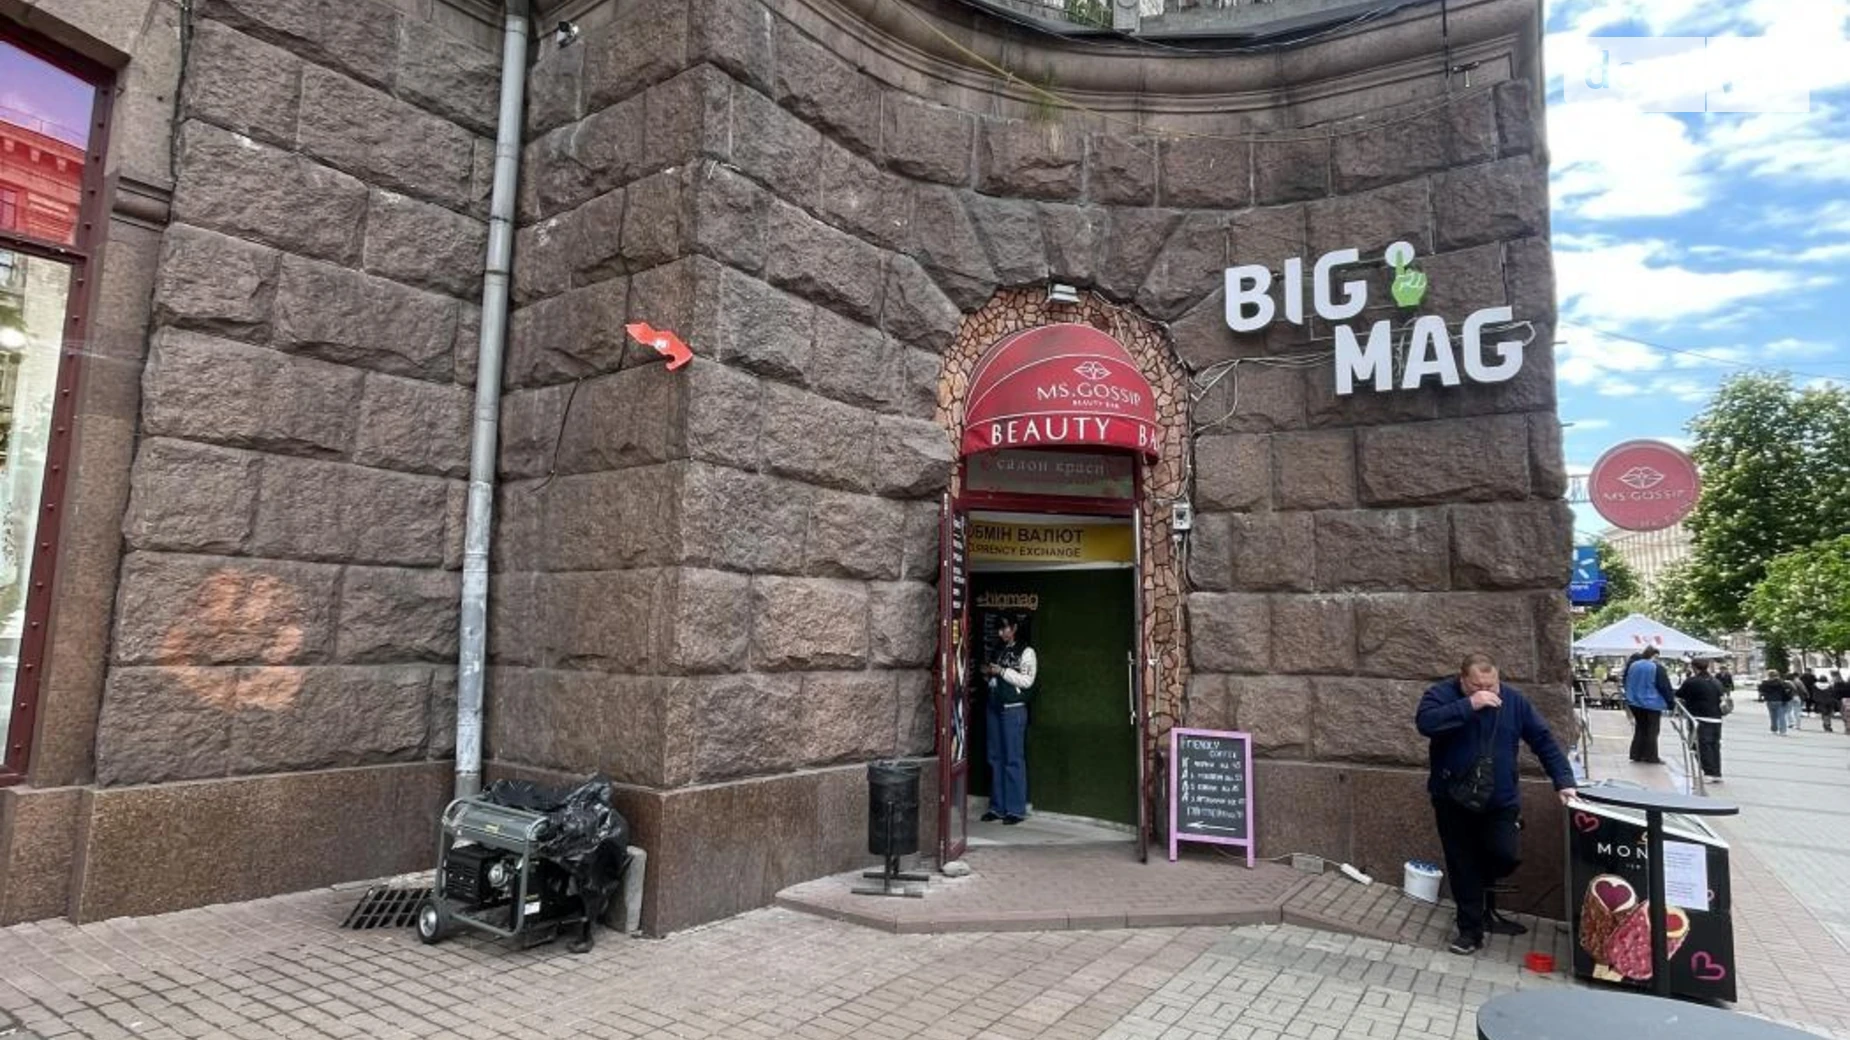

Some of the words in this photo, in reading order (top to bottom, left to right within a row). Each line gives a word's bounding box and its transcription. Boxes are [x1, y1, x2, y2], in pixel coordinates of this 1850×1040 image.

[1225, 248, 1367, 333] BIG
[1335, 306, 1524, 396] MAG
[991, 416, 1111, 446] BEAUTY
[1138, 424, 1158, 451] BA
[996, 458, 1048, 472] салон
[1017, 528, 1085, 544] ВАЛЮТ
[1019, 547, 1081, 558] EXCHANGE
[1597, 842, 1649, 859] MON
